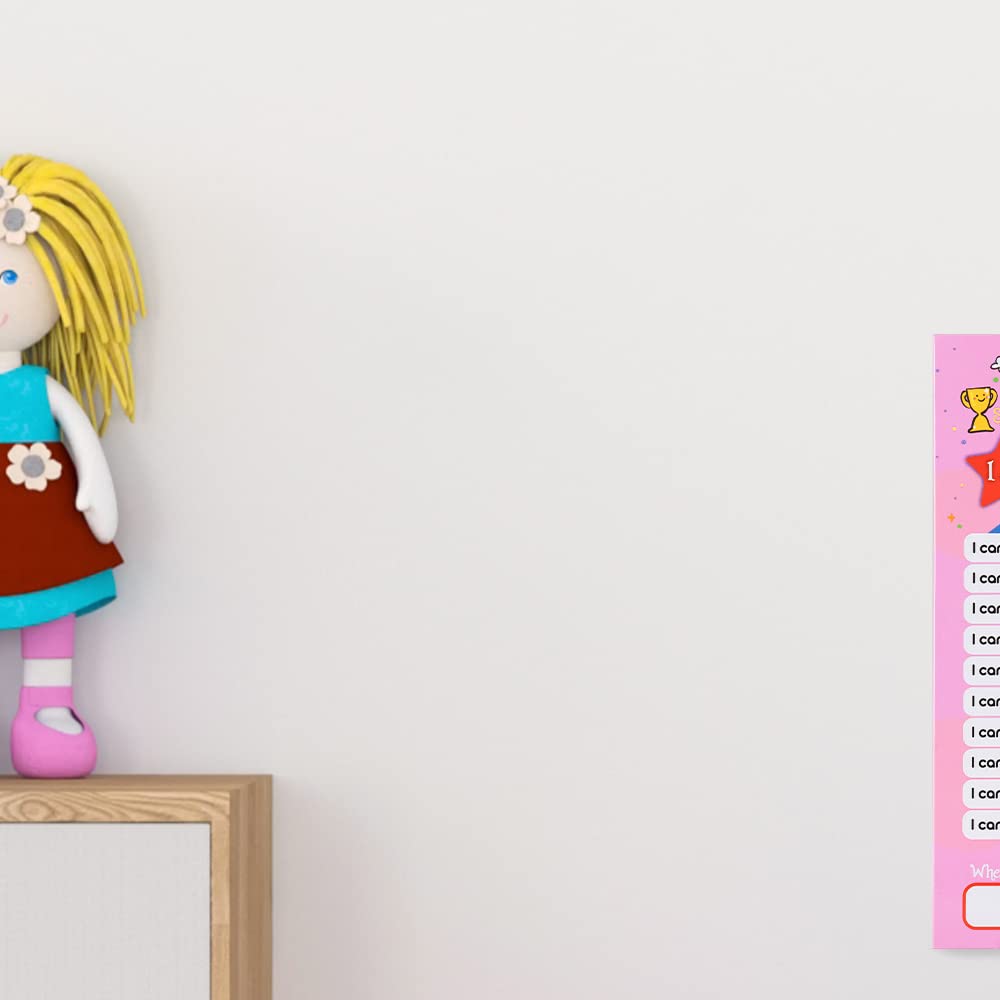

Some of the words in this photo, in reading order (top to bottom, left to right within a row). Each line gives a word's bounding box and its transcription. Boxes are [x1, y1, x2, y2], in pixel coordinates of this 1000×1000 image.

[987, 460, 995, 482] I
[972, 542, 976, 554] I
[972, 572, 976, 584] I
[972, 602, 976, 614] I
[972, 633, 975, 645] I
[972, 664, 975, 676] I
[971, 695, 975, 707] I
[971, 726, 975, 738] I
[971, 757, 975, 768] I
[971, 787, 975, 799] I
[971, 818, 974, 830] I
